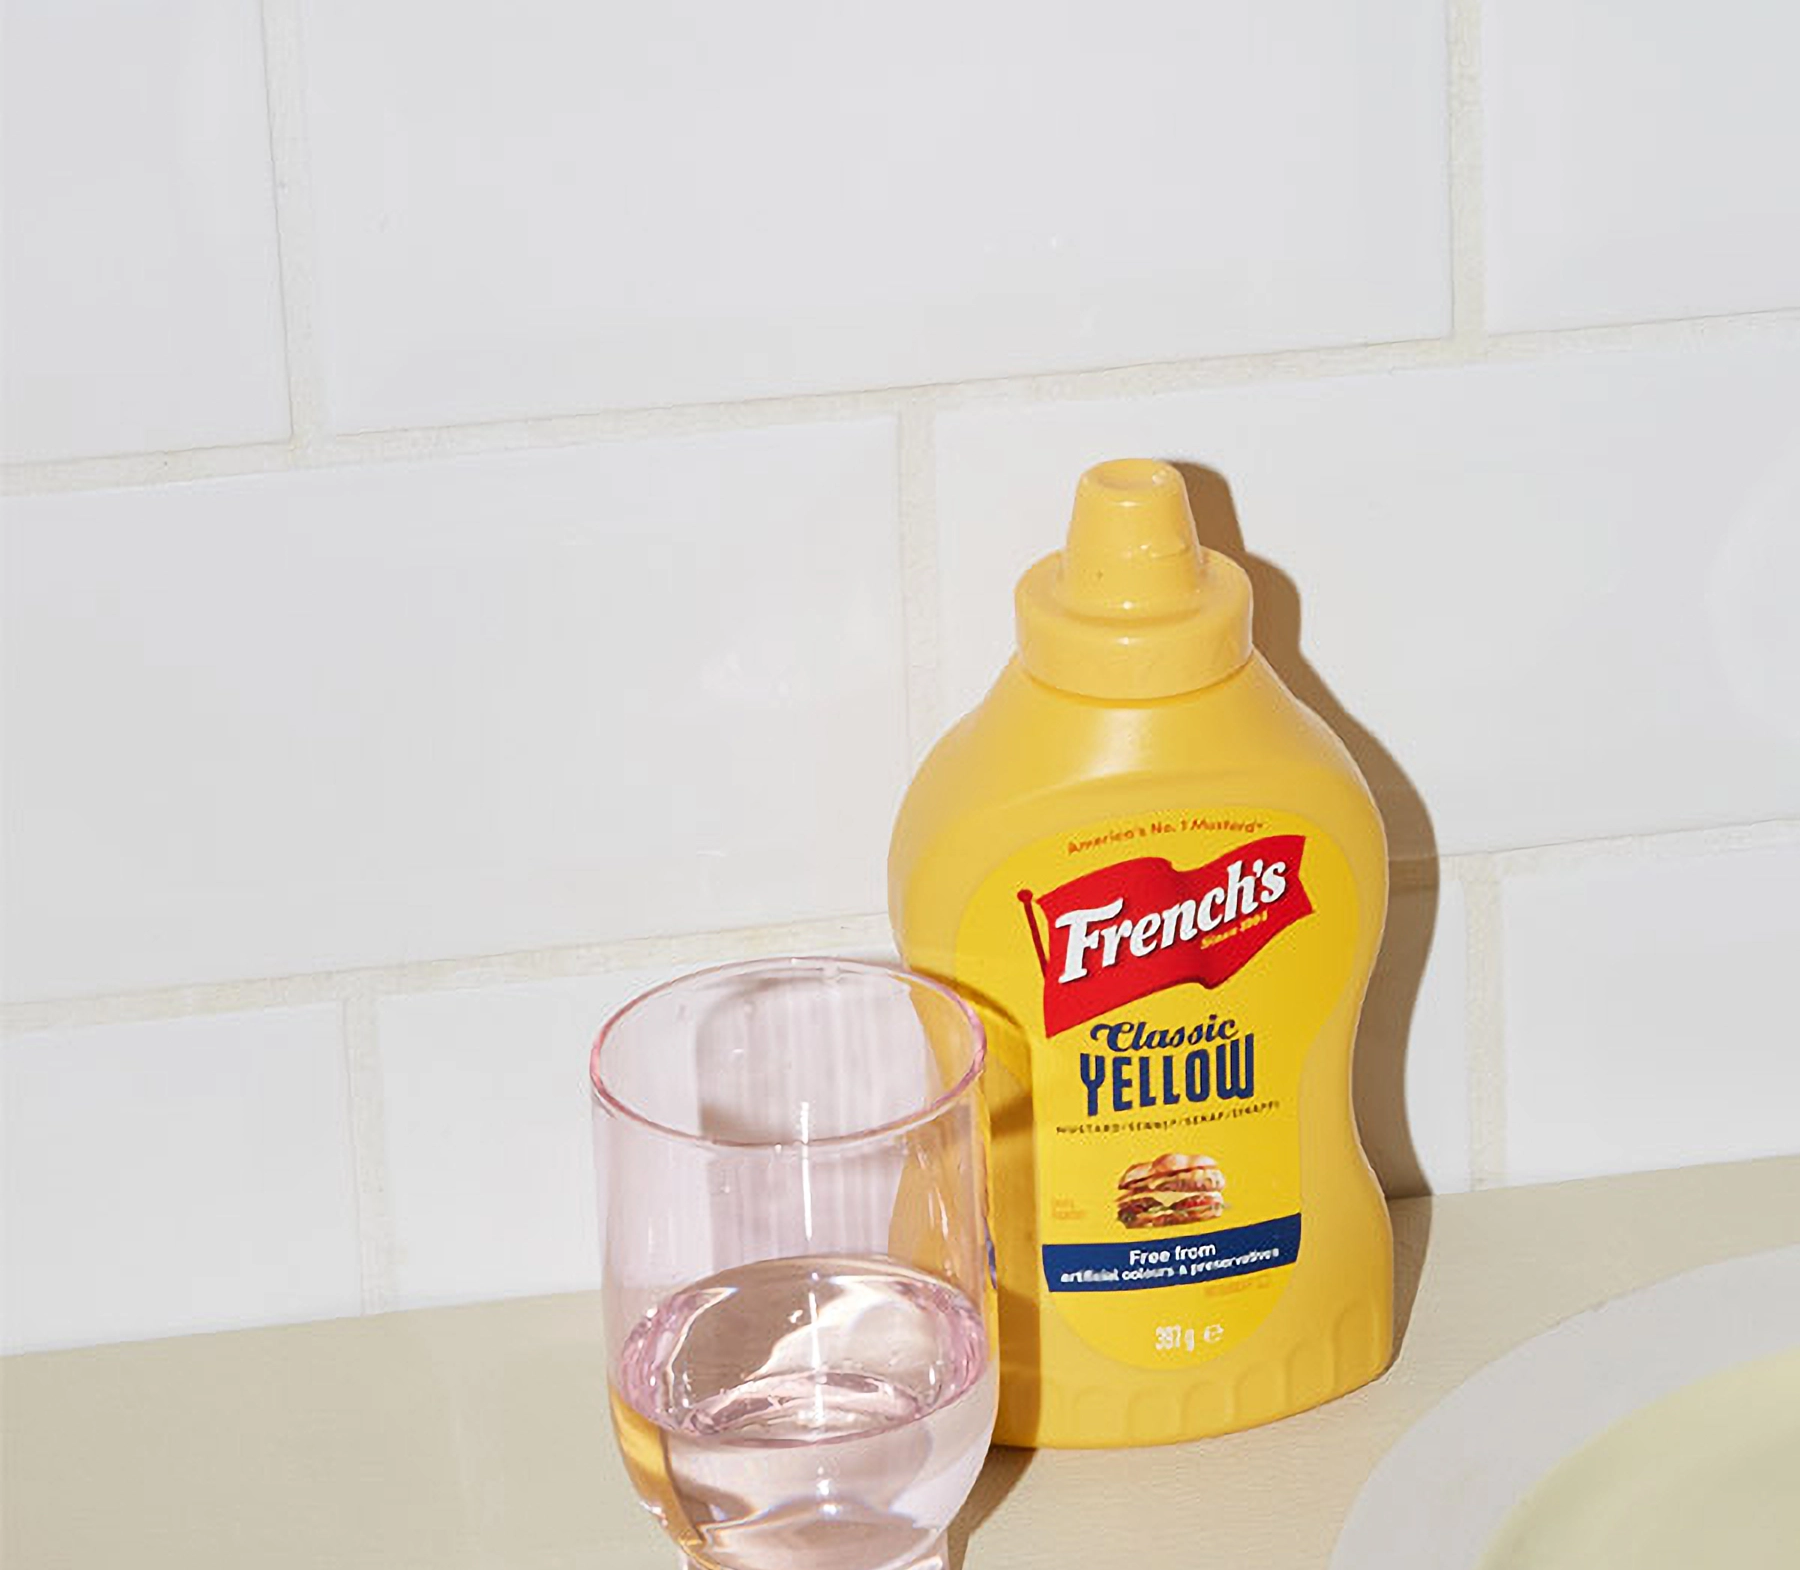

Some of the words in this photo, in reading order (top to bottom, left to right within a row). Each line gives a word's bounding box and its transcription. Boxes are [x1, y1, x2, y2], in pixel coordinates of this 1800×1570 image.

[1067, 827, 1147, 856] America's
[1151, 821, 1176, 834] No.
[1055, 859, 1287, 984] French's
[1089, 1013, 1239, 1053] Classic
[1080, 1032, 1255, 1117] YELLOW
[1121, 1266, 1175, 1281] colours
[1190, 1247, 1280, 1277] preservatives
[1129, 1249, 1171, 1267] Free
[1174, 1243, 1217, 1261] from
